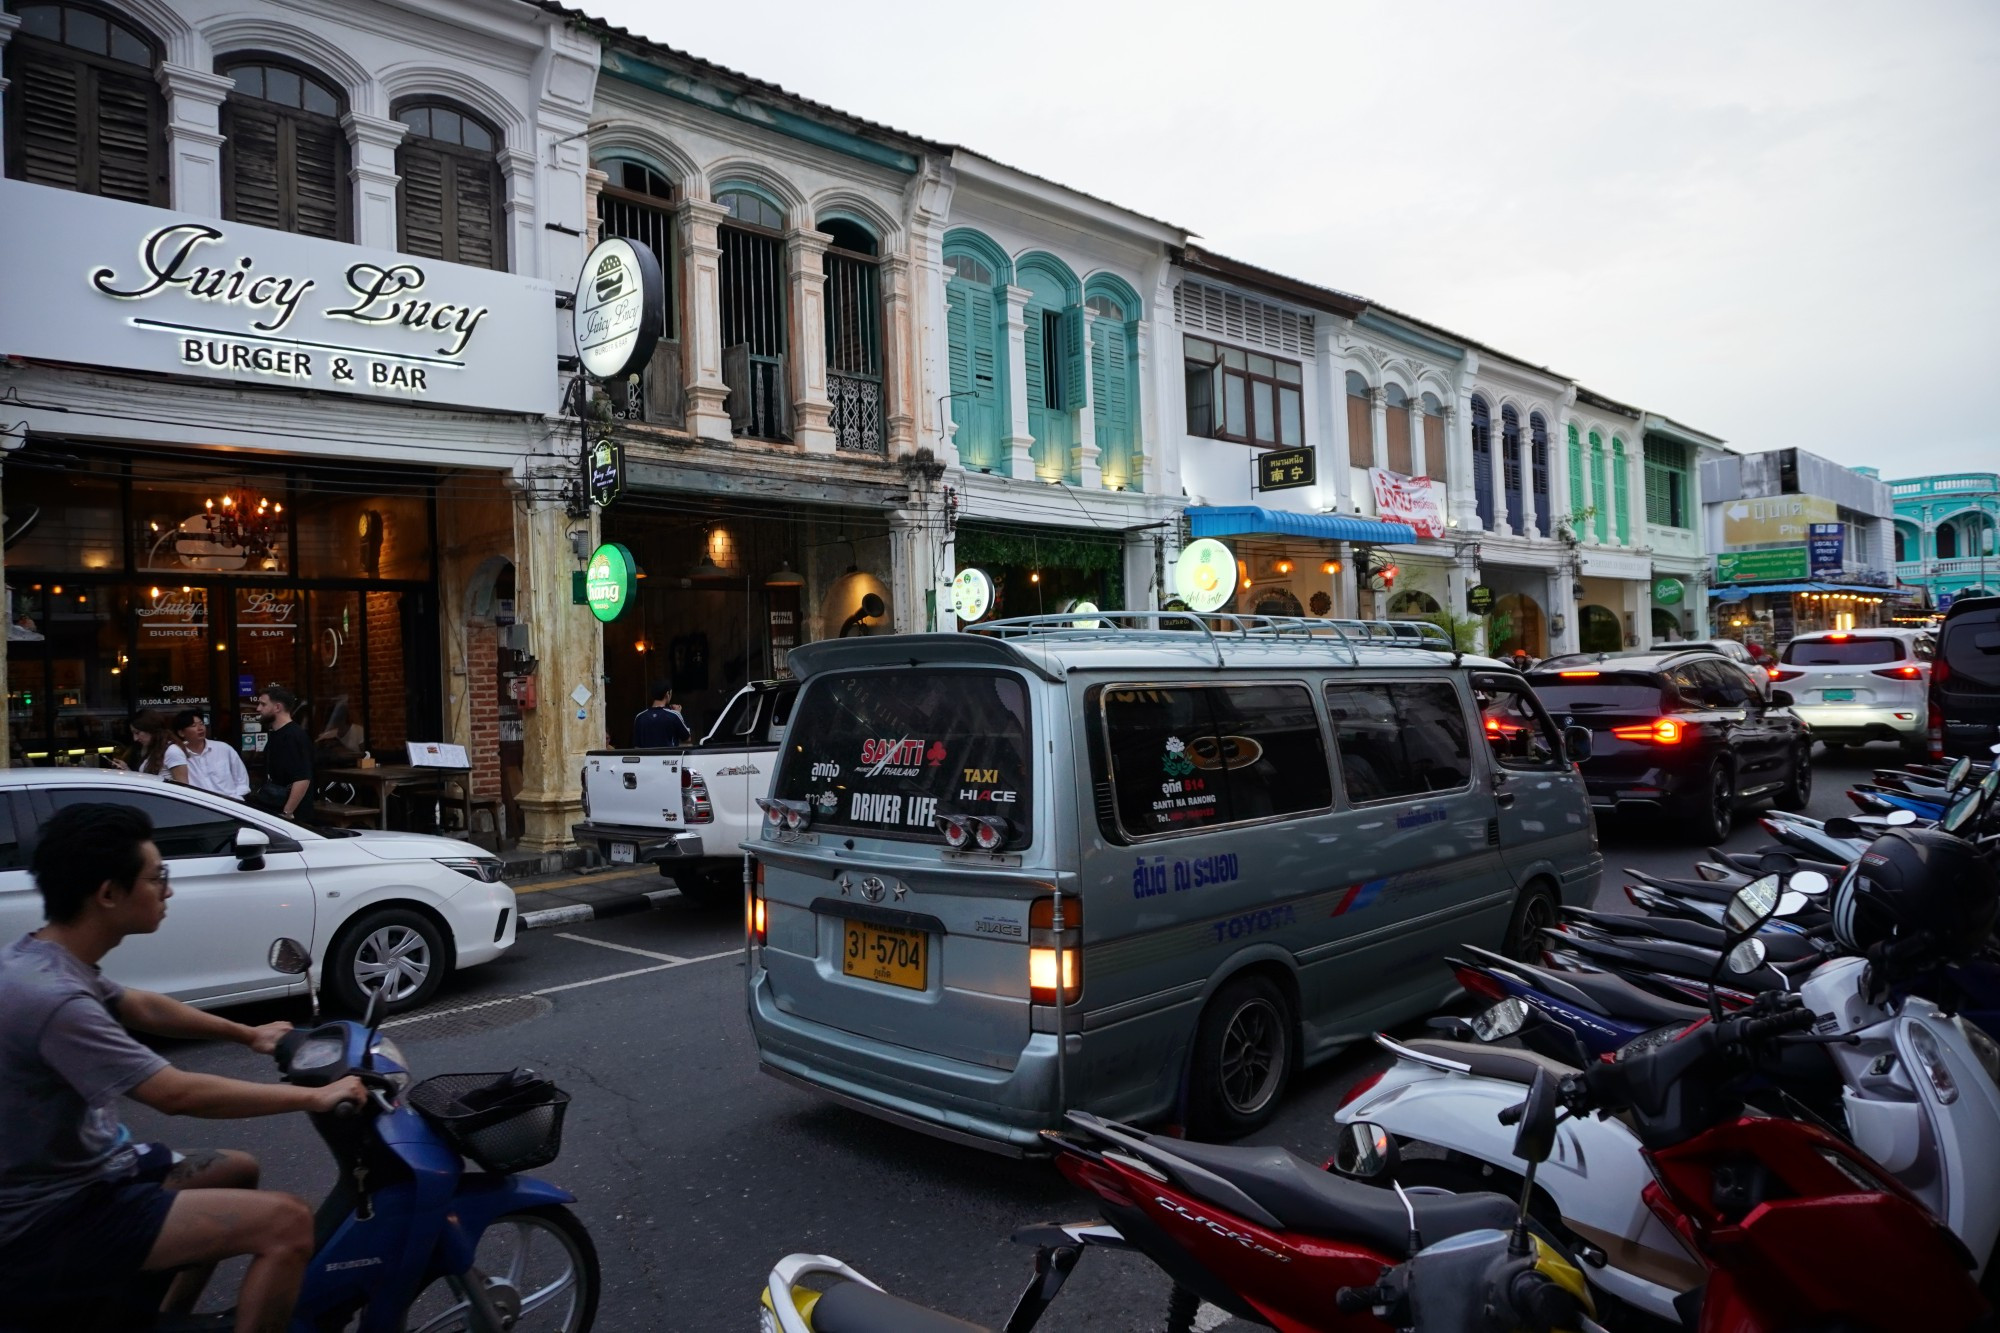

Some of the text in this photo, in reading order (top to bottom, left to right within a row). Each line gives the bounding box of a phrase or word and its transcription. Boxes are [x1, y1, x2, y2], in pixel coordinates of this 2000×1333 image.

[93, 224, 488, 356] Juicy Lucy
[580, 299, 639, 341] Juicy Lucy
[184, 338, 427, 391] BURGER & BAR
[139, 590, 203, 622] Juicy
[241, 592, 295, 622] Lucy
[162, 684, 184, 692] OPEN
[882, 767, 920, 777] THAILAND
[963, 768, 999, 784] TAXI
[850, 792, 938, 828] DRIVER LIFE
[959, 788, 1017, 803] HIACE
[1152, 794, 1217, 811] SANTI NA RANONG
[1194, 853, 1239, 888] ระนอง
[975, 920, 1022, 937] HIACE
[1214, 905, 1296, 943] TOYOTA
[849, 930, 920, 970] 31-5704
[325, 1256, 384, 1272] HONDA
